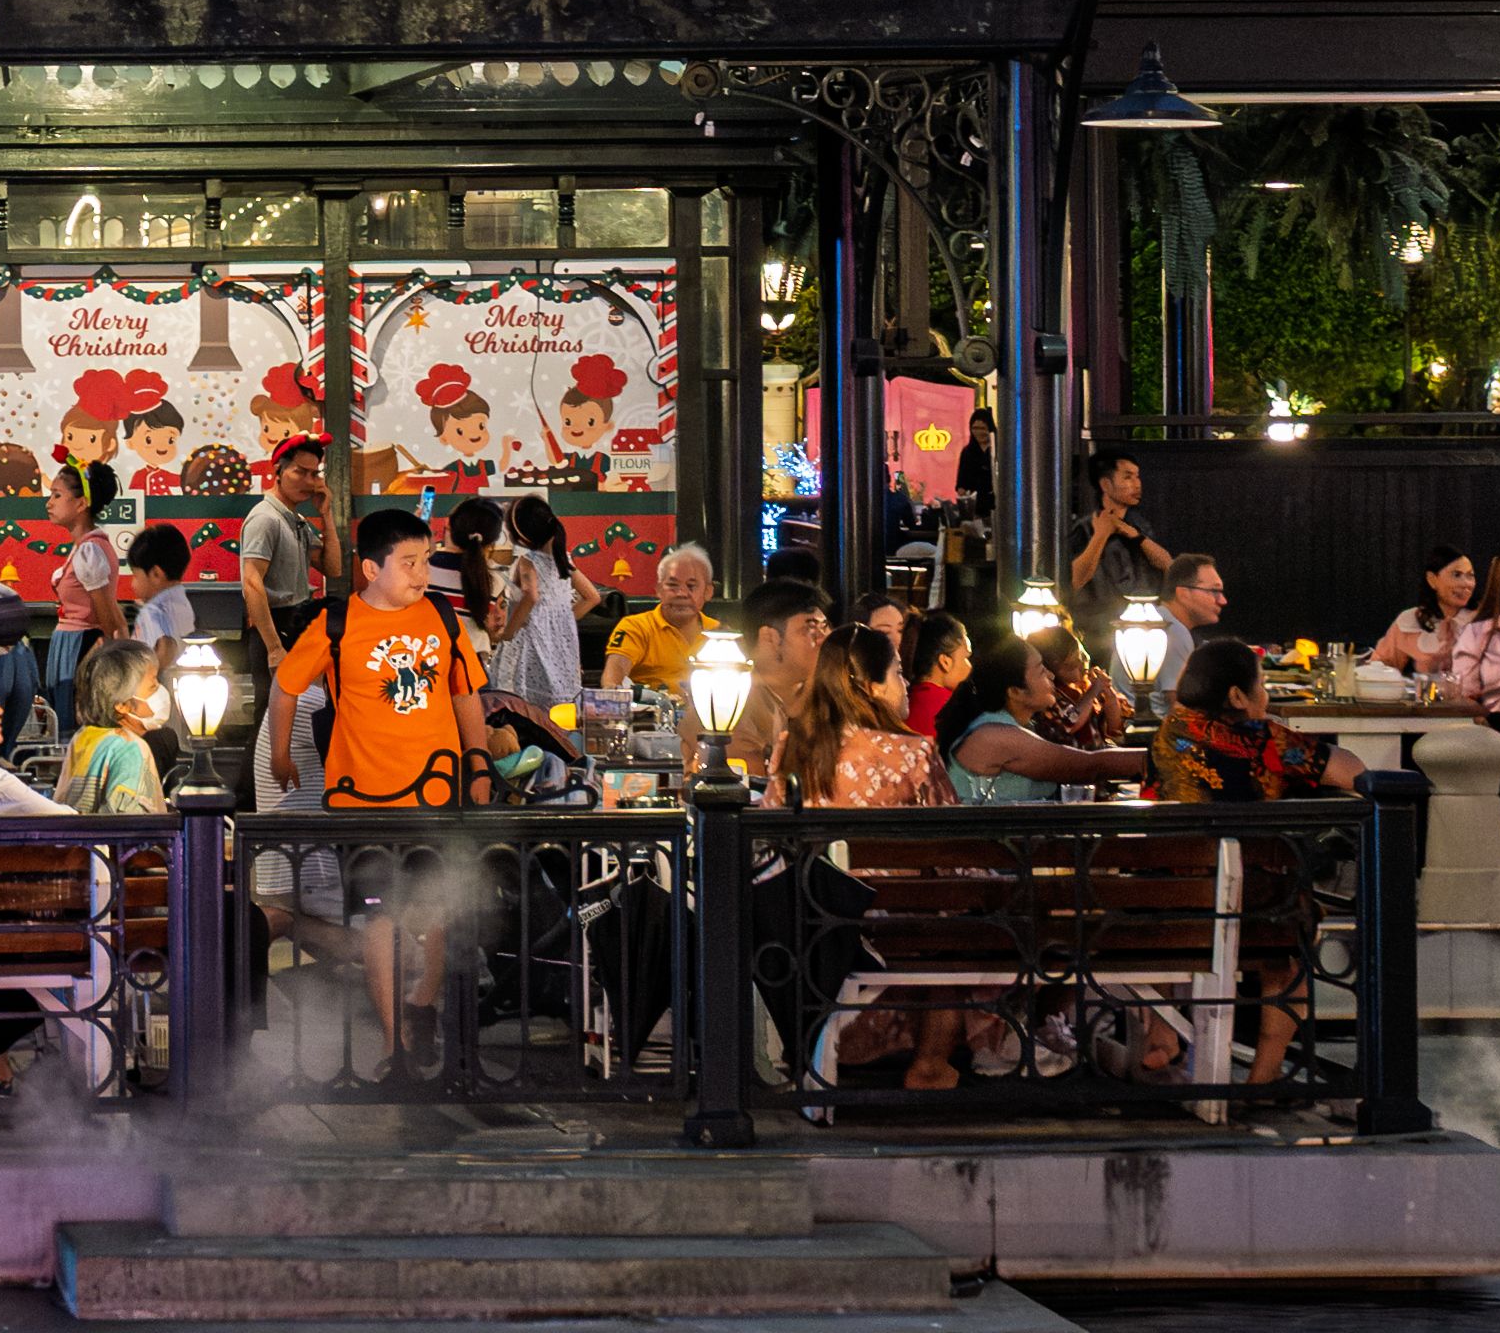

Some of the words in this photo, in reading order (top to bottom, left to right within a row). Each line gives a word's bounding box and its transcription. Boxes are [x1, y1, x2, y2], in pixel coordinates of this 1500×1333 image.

[68, 307, 149, 339] Merry
[484, 304, 565, 336] Merry
[48, 333, 168, 357] Christmas
[464, 330, 583, 354] Christmas
[613, 458, 651, 470] FLOUR
[99, 504, 133, 520] 5:12
